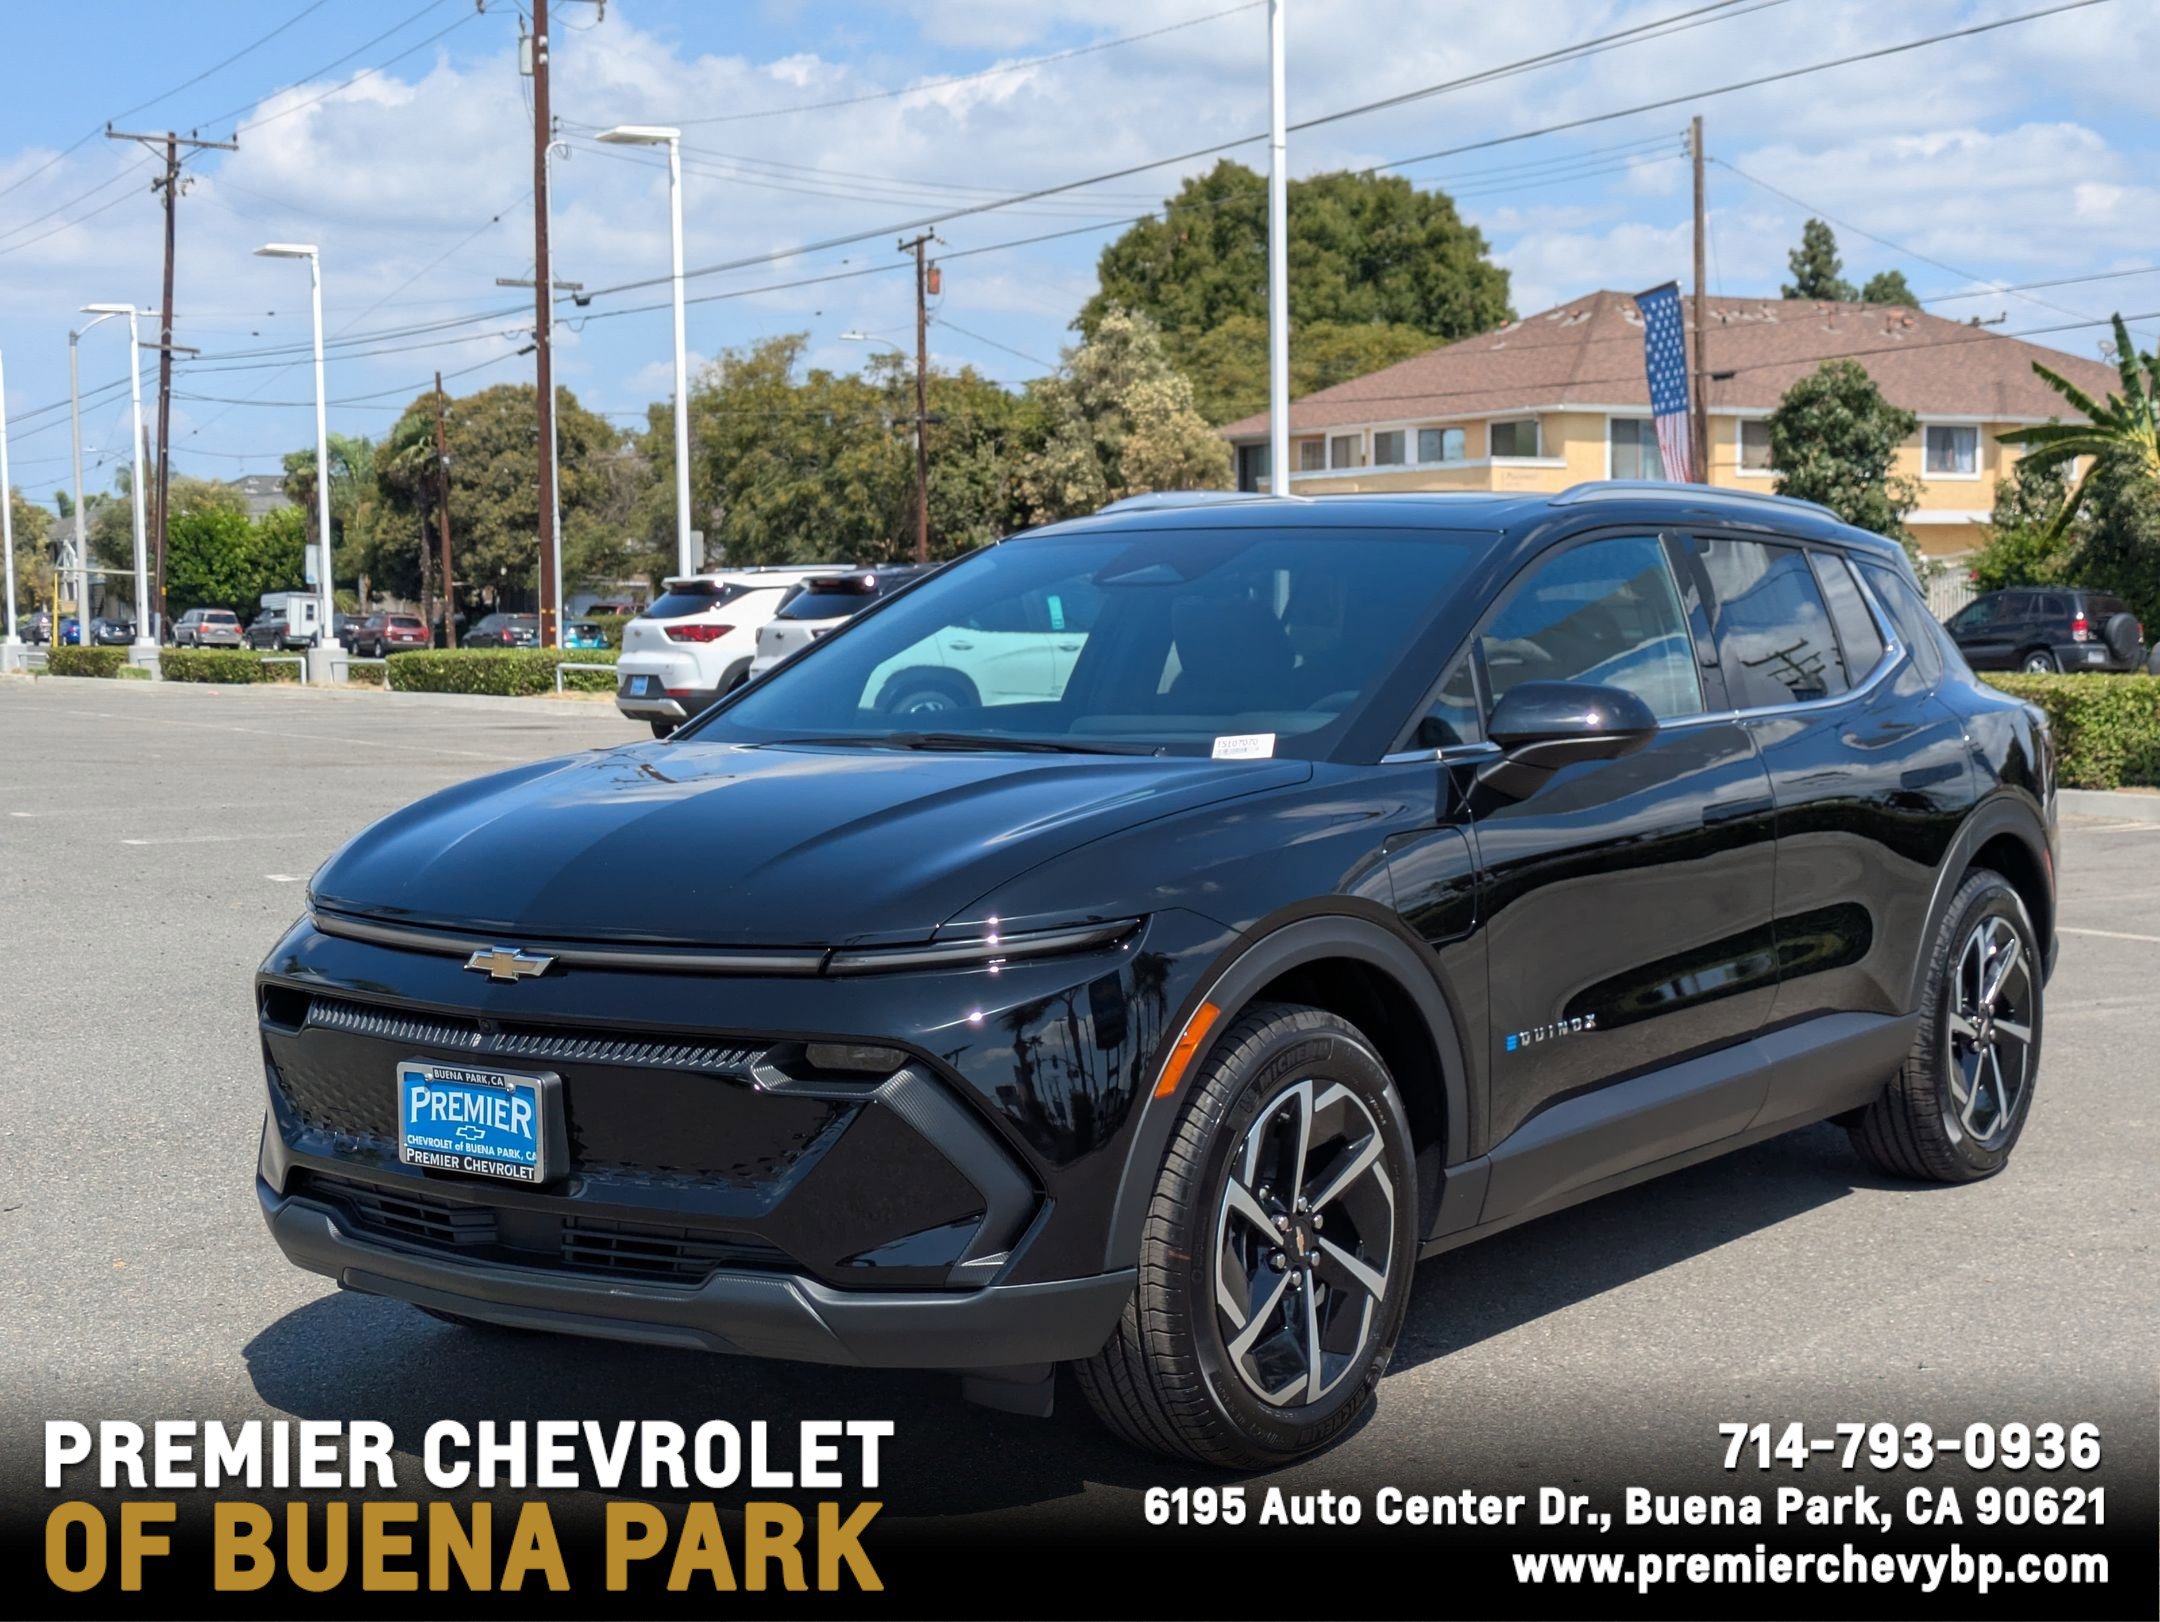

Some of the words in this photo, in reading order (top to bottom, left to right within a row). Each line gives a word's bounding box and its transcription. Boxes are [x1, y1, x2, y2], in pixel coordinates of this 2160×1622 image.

[433, 1069, 463, 1081] BUENA
[410, 1086, 532, 1140] PREMIER
[407, 1134, 453, 1150] CHEVROLET
[455, 1141, 464, 1151] of
[466, 1143, 495, 1156] BUENA
[497, 1148, 523, 1161] PARK,
[406, 1148, 459, 1169] PREMIER
[464, 1157, 534, 1179] CHEVROLET
